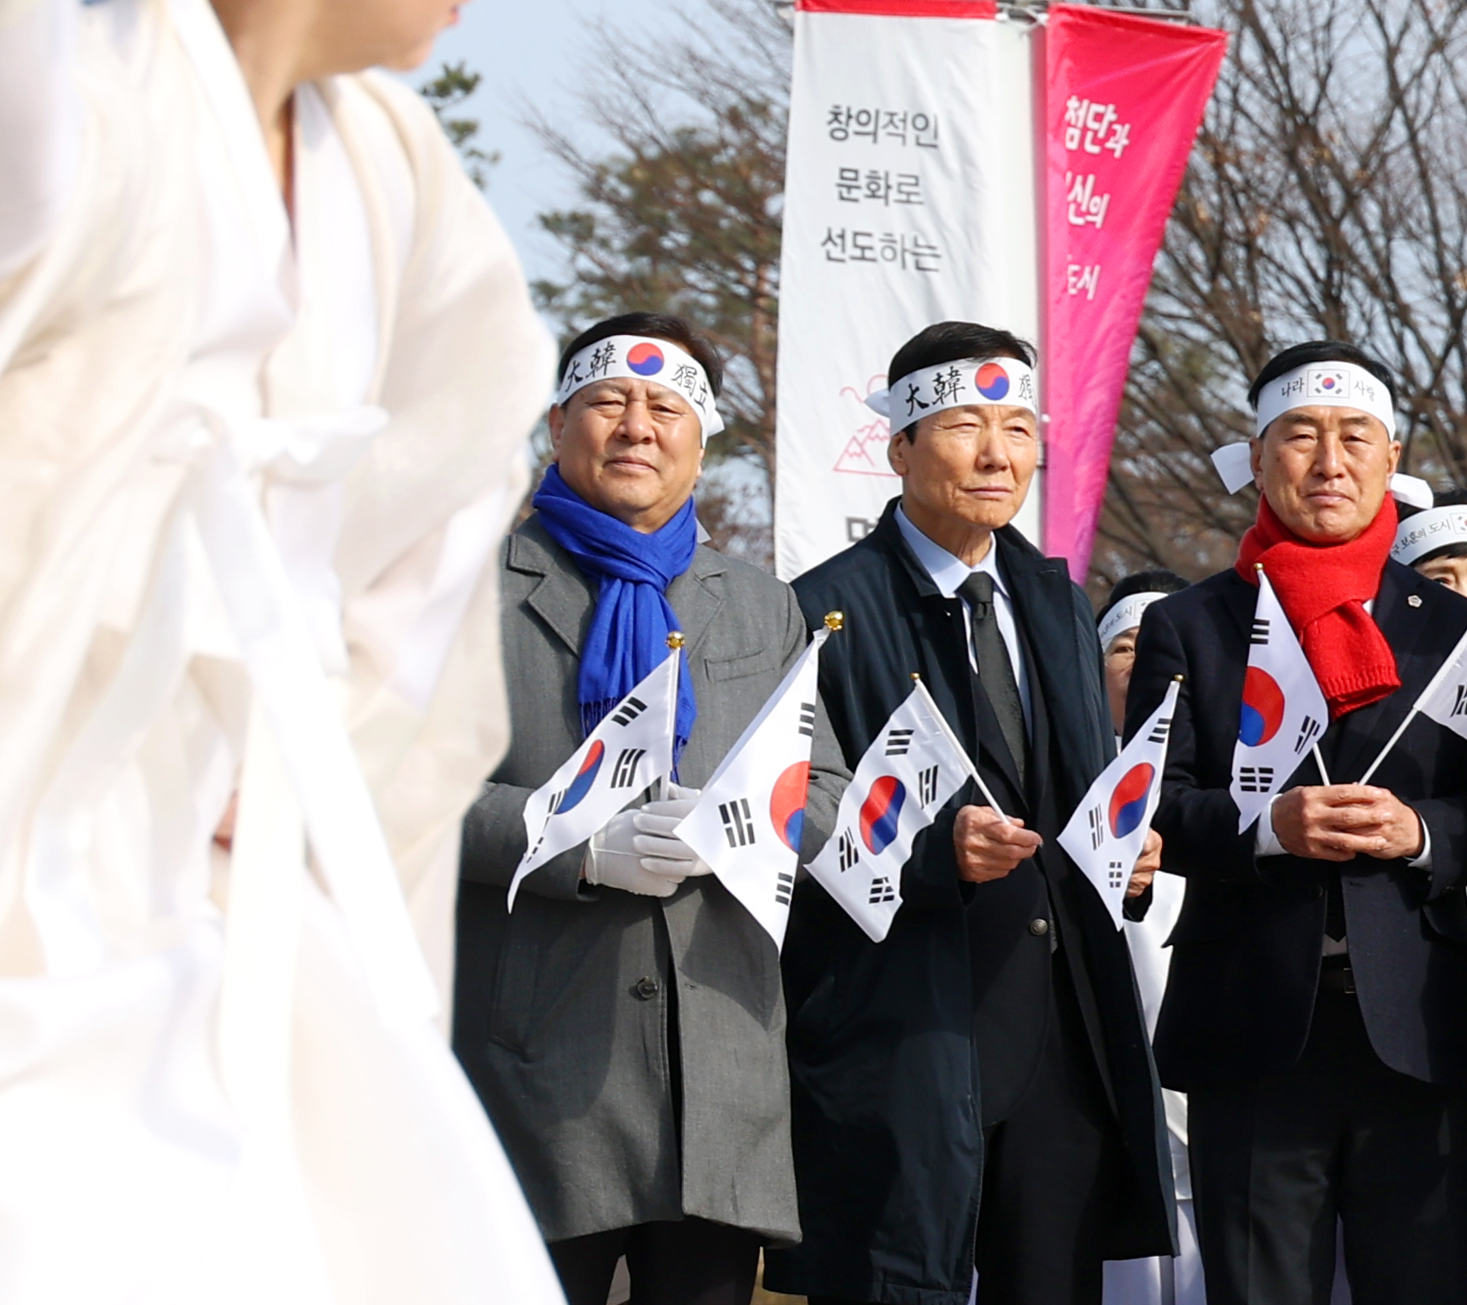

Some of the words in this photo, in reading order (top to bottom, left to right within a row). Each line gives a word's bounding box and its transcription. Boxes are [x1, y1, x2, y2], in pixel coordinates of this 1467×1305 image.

[826, 105, 940, 150] 창의적인
[1065, 95, 1131, 159] 첨단과
[835, 167, 924, 207] 문화로
[1065, 170, 1111, 229] 신의
[821, 227, 943, 273] 선도하는
[565, 341, 617, 393] 大韓
[671, 363, 709, 415] 獨立
[905, 365, 966, 418] 大韓
[1281, 377, 1305, 398] 나라
[1353, 379, 1376, 402] 사랑
[1400, 528, 1427, 550] 보훈의
[1429, 518, 1452, 534] 도시
